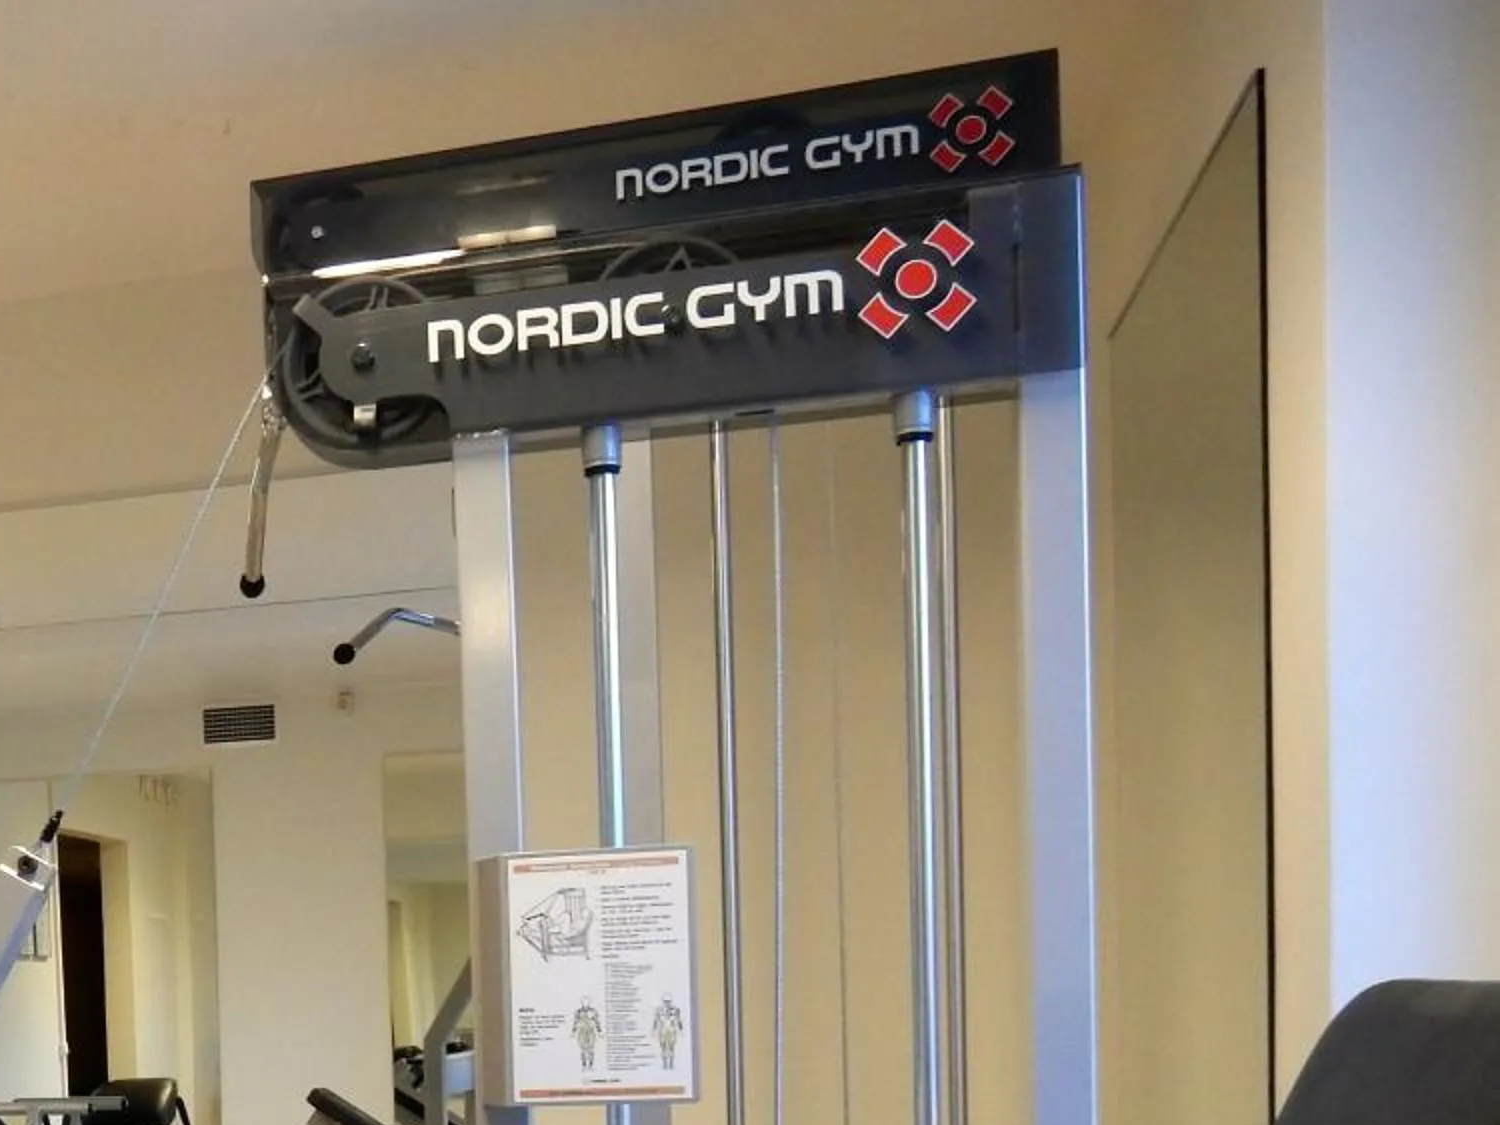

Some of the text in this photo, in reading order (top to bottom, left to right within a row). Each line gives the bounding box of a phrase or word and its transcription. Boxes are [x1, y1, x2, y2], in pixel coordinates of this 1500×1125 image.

[615, 124, 919, 201] NORDIC GYM
[427, 269, 844, 363] NORDIC GYM
